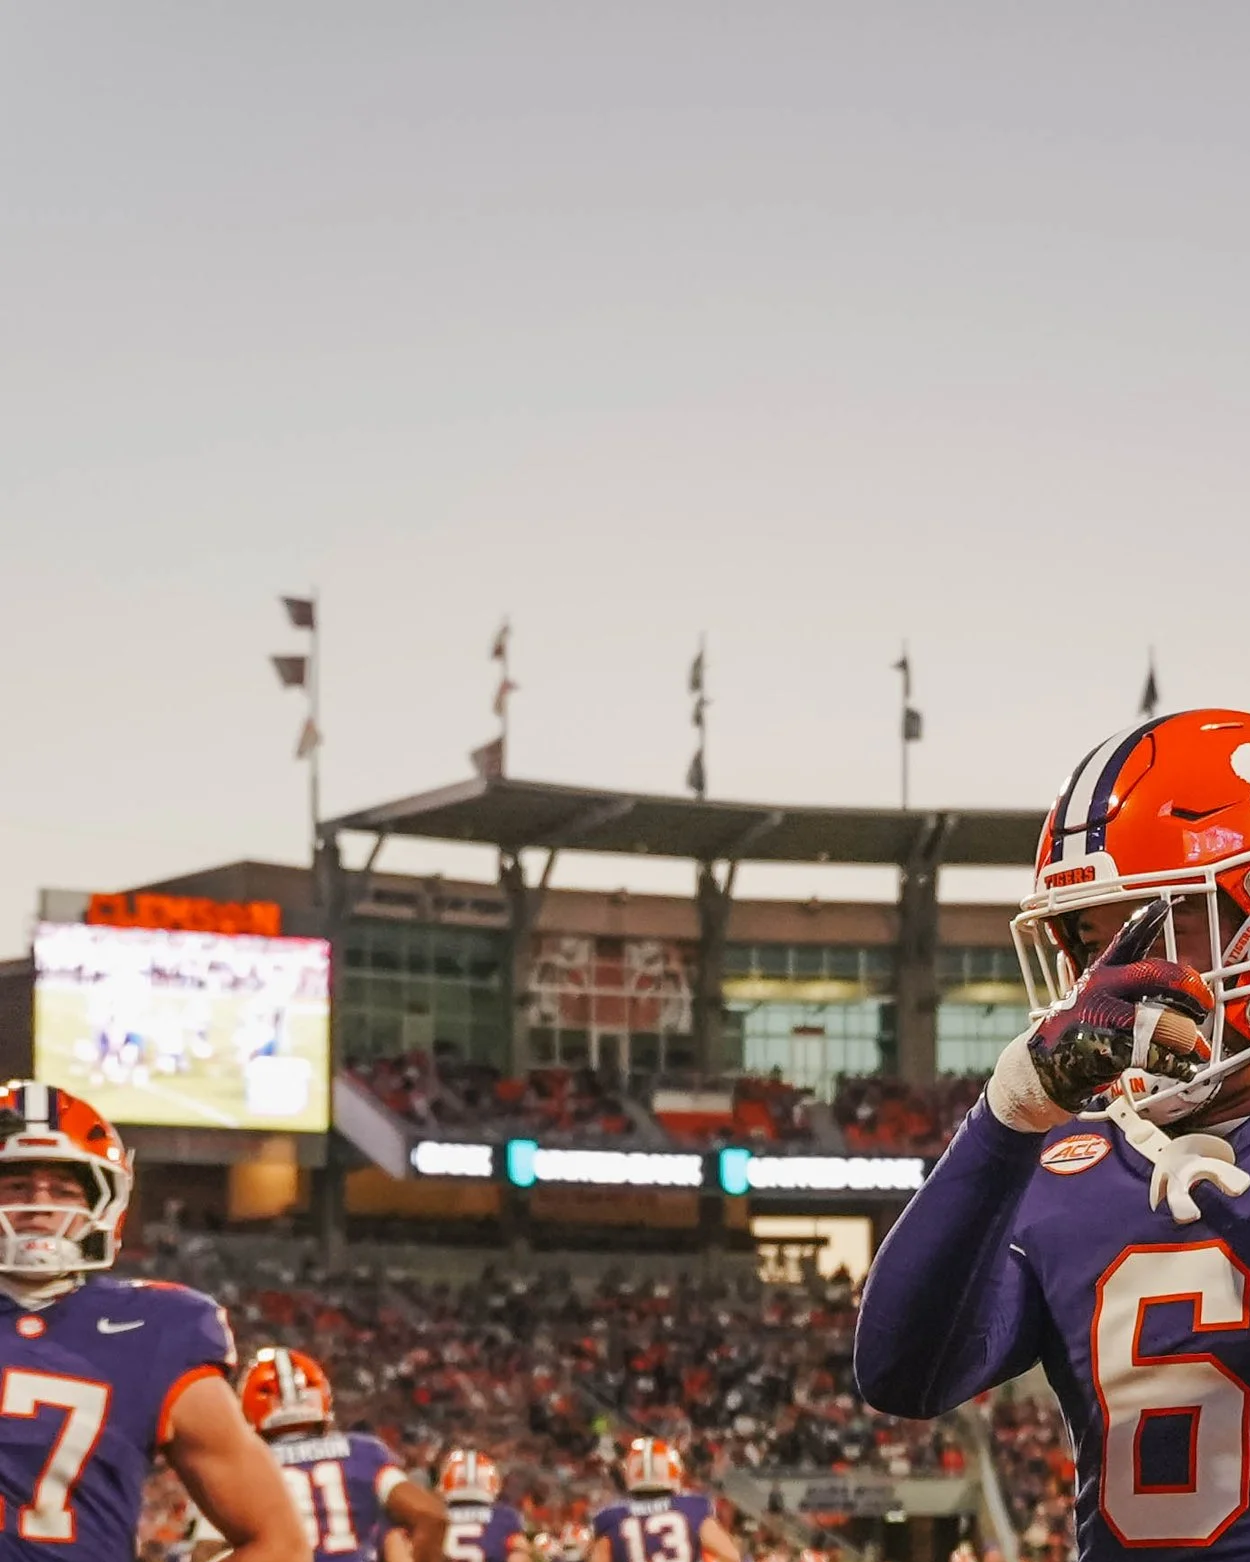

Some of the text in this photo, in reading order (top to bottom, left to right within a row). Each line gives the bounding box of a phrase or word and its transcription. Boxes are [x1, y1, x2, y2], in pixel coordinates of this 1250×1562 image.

[1044, 865, 1096, 890] TIGERS
[1129, 1076, 1146, 1093] IN
[1050, 1140, 1104, 1161] ACC
[0, 1366, 112, 1543] 7
